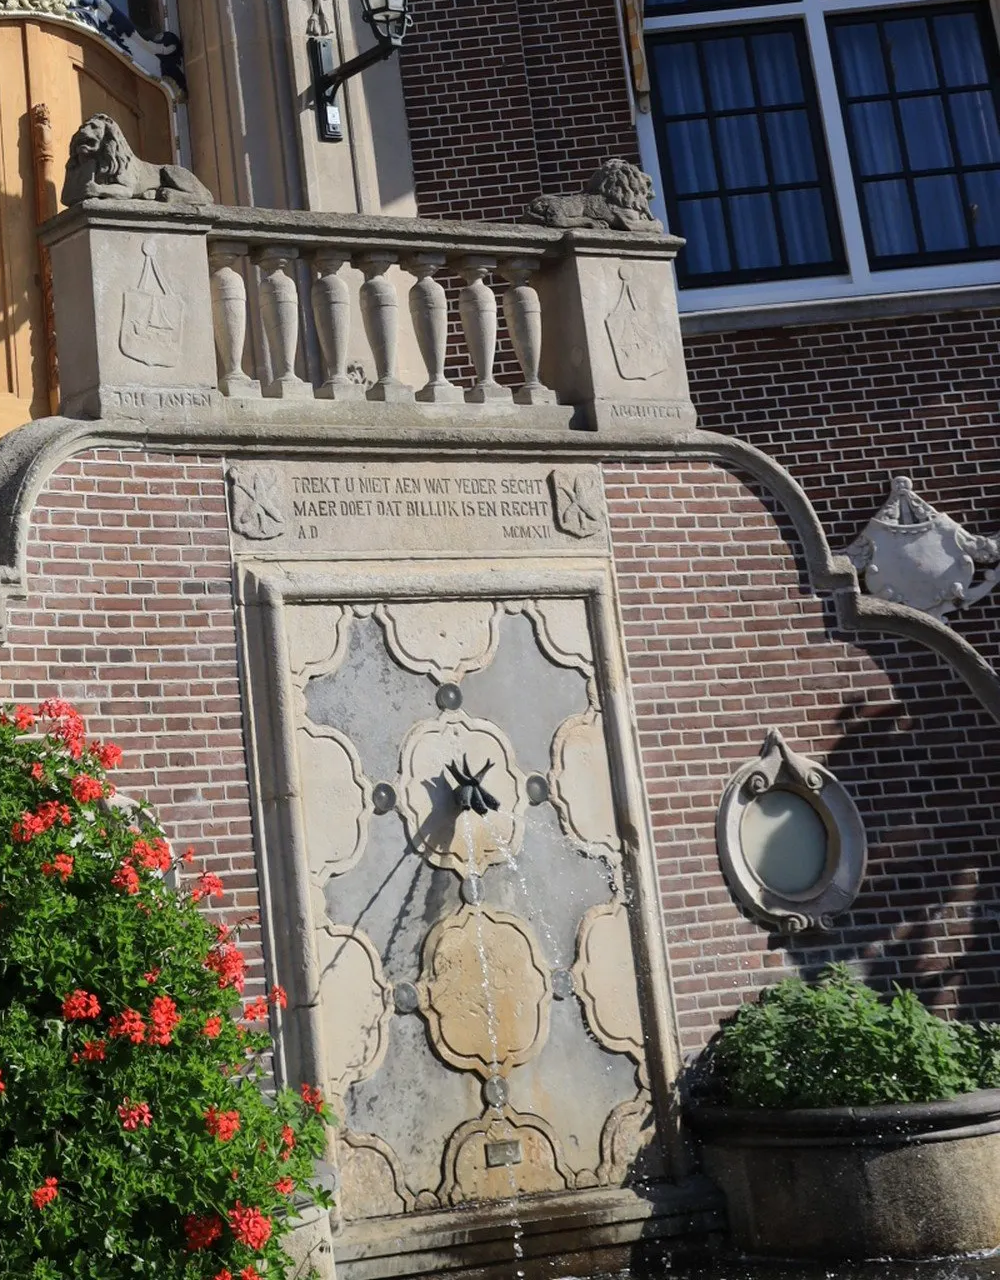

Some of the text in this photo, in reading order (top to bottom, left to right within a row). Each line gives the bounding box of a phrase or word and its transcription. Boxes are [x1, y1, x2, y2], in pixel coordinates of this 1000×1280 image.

[610, 404, 682, 419] ARCHITECT
[292, 477, 543, 495] TREKT U NIET AEN WAT YEDER SECHT
[293, 500, 338, 517] MAER
[340, 500, 372, 516] DOET
[376, 500, 402, 517] DAT
[461, 500, 475, 517] IS
[477, 500, 498, 517] EN
[500, 500, 549, 517] RECHT
[502, 525, 552, 540] MCMXII
